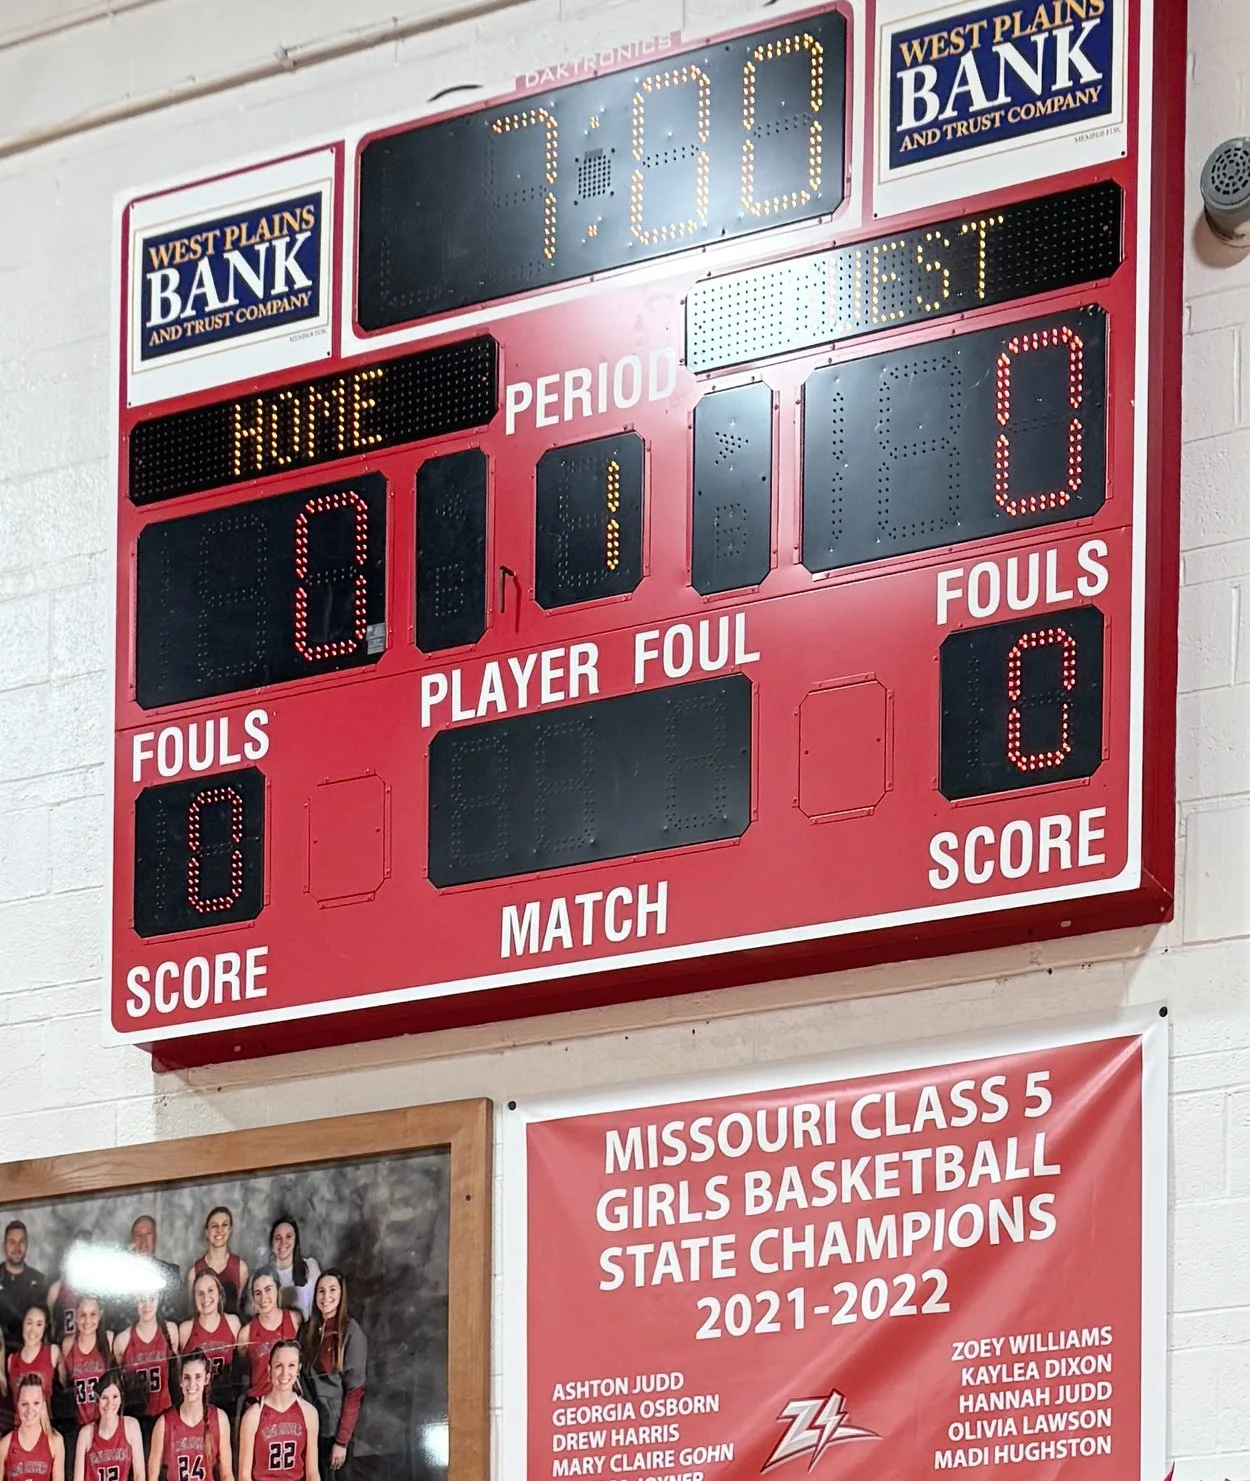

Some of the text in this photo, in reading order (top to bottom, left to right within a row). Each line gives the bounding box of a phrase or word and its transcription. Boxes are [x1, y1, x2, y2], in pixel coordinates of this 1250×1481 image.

[525, 35, 672, 89] DAKTRONICS
[900, 0, 1105, 68] WEST PLAINS
[896, 18, 1103, 132] BANK
[492, 32, 824, 261] 7:00
[900, 85, 1103, 152] AND TRUST COMPANY
[149, 204, 315, 270] WEST PLAINS
[146, 231, 313, 328] BANK
[149, 291, 313, 346] AND TRUST COMPANY
[233, 368, 385, 477] HOME
[504, 346, 678, 436] PERIOD
[995, 326, 1084, 517] 0
[606, 459, 620, 572] 1
[295, 489, 368, 662] 0
[936, 540, 1110, 626] FOULS
[420, 611, 761, 729] PLAYER FOUL
[132, 708, 270, 783] FOULS
[188, 787, 243, 913] 0
[928, 806, 1107, 891] SCORE
[500, 880, 670, 960] MATCH
[126, 945, 269, 1019] SCORE
[604, 1070, 1053, 1175] MISSOURI CLASS 5
[596, 1131, 1061, 1232] GIRLS BASKETBALL
[599, 1193, 1057, 1291] STATE CHAMPIONS
[695, 1268, 951, 1340] 2021-2022
[951, 1325, 1113, 1361] ZOEY WILLIAMS
[961, 1353, 1112, 1387] KAYLEA DIXON
[552, 1371, 685, 1402] ASHTON JUDD
[552, 1394, 720, 1427] GEORGIA OSBORN
[959, 1381, 1113, 1414] HANNAH JUDD
[268, 1440, 297, 1471] 22
[552, 1443, 735, 1477] MARY CLAIRE GOHN
[553, 1423, 680, 1453] DREW HARRIS
[934, 1435, 1112, 1470] MADI HUGHSTON
[948, 1408, 1112, 1442] OLIVIA LAWSON
